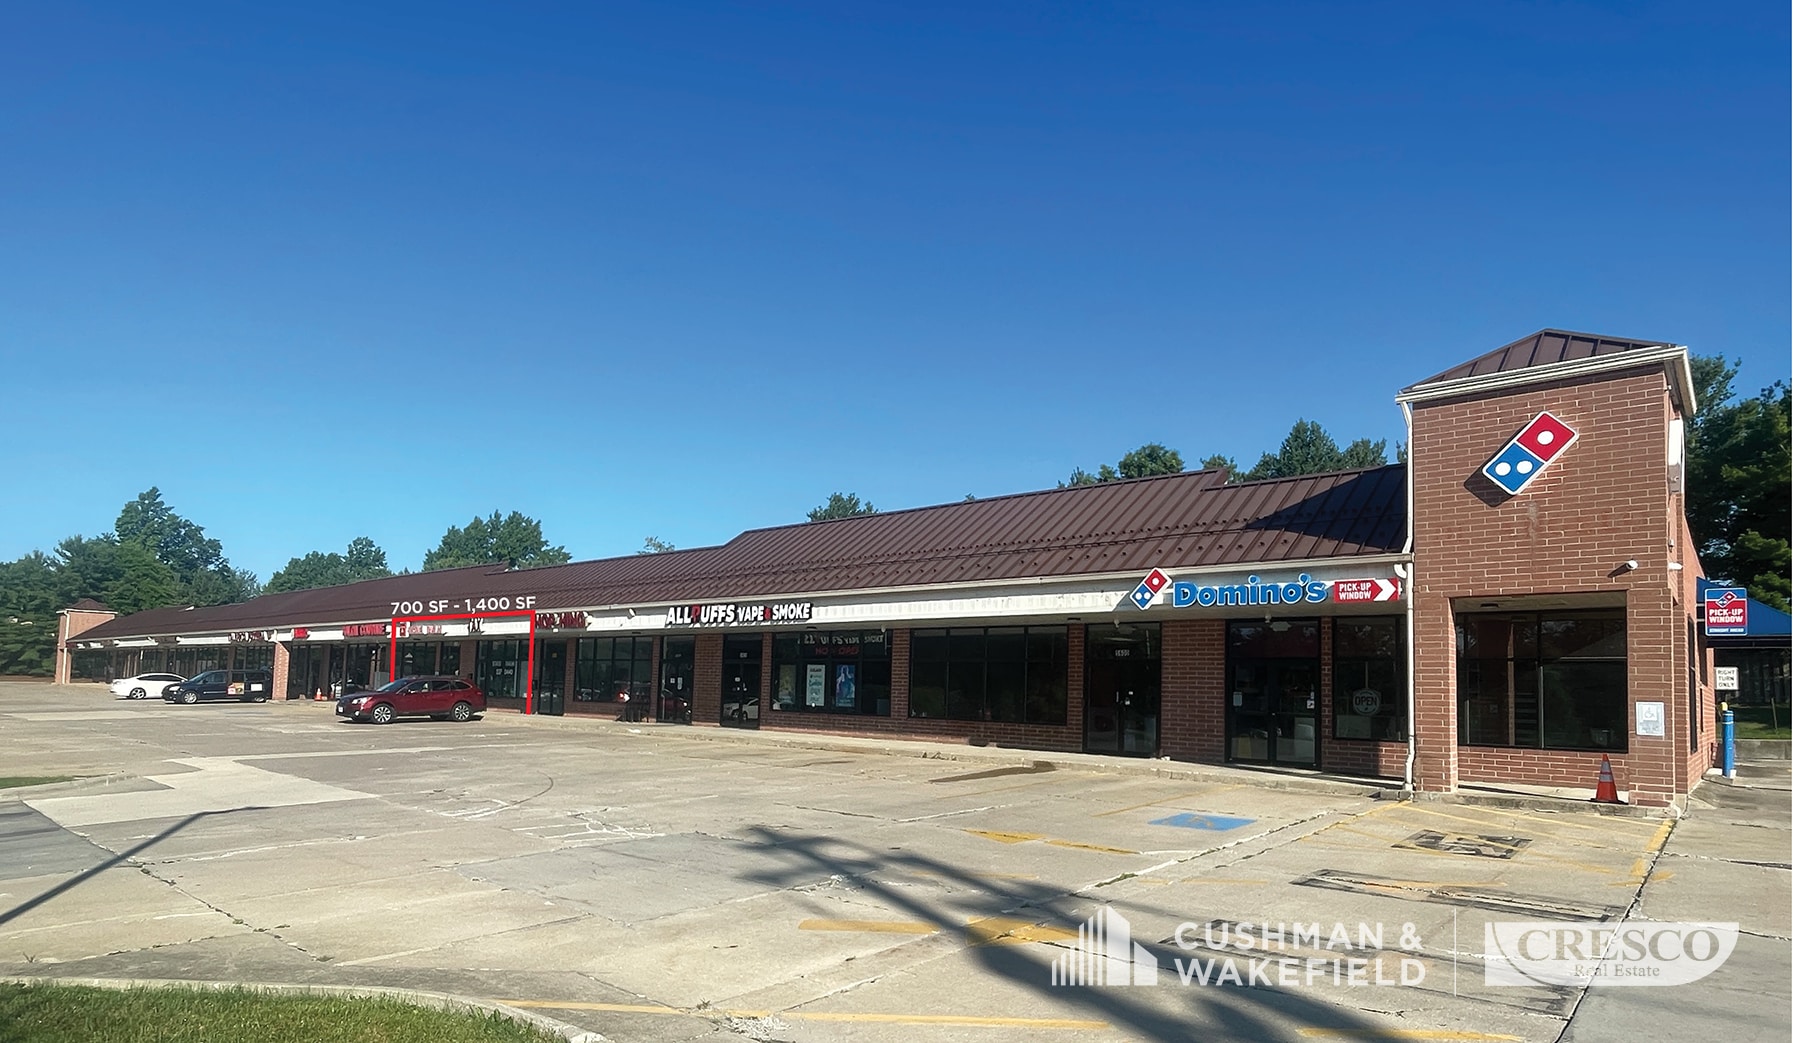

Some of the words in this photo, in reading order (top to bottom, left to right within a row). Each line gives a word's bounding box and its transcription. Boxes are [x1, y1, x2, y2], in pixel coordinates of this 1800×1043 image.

[1173, 573, 1328, 608] Domino's
[1339, 582, 1372, 592] PICK-UP
[1338, 591, 1372, 600] WINDOW
[737, 605, 764, 621] VAPE
[772, 603, 811, 620] SMOKE
[1708, 608, 1744, 616] PICK-UP
[1354, 695, 1378, 706] OPEN
